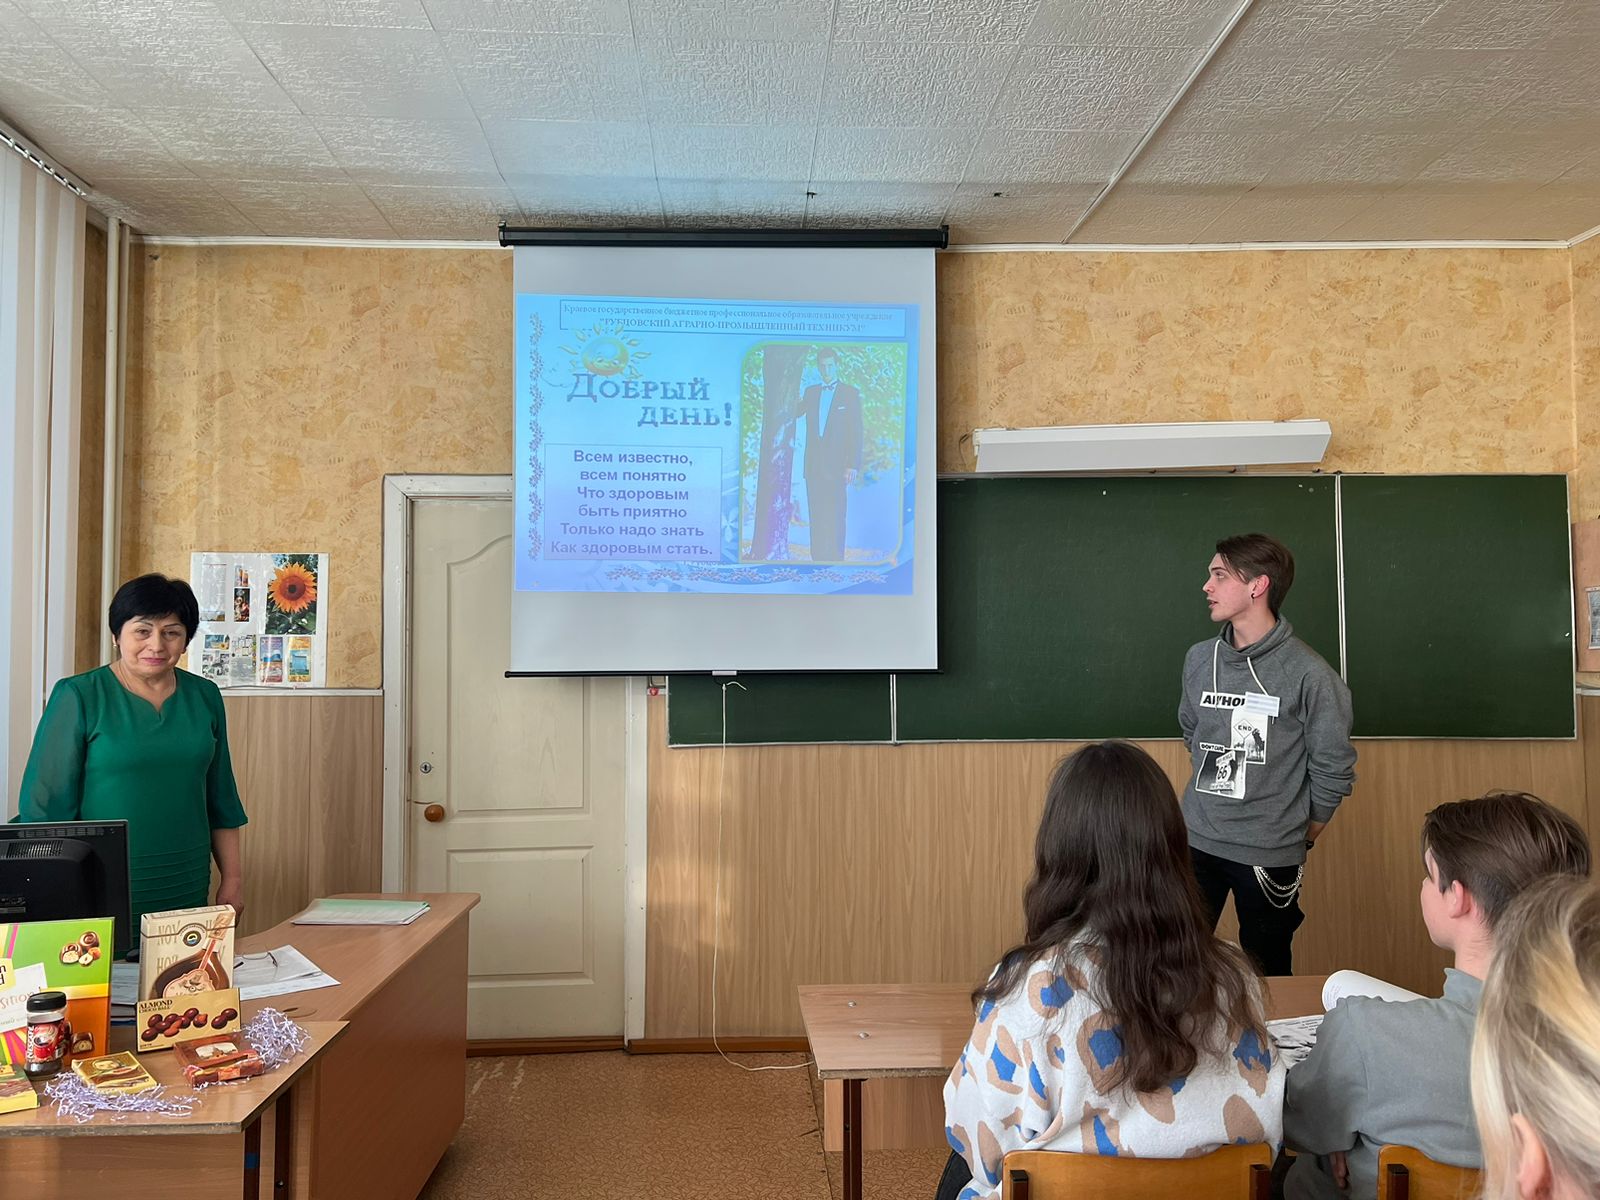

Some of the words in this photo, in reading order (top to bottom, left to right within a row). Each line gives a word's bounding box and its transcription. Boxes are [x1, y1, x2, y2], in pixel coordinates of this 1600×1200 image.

[564, 304, 597, 313] Краевое
[598, 306, 663, 316] государственное
[664, 307, 707, 316] бюджетное
[709, 308, 781, 319] профессиональное
[672, 319, 806, 331] АГРАРНО-ПРОМЫШЛЕННЫЙ
[574, 450, 613, 463] Всем
[618, 453, 693, 466] известно,
[580, 470, 618, 481] всем
[622, 471, 687, 482] понятно
[577, 486, 605, 499] Что
[609, 489, 689, 501] здоровым
[578, 504, 620, 517] быть
[623, 507, 688, 520] приятно
[560, 522, 615, 535] Только
[619, 525, 657, 537] надо
[661, 526, 705, 537] знать
[551, 541, 577, 553] Как
[581, 542, 662, 556] здоровым
[666, 544, 713, 555] стать.
[139, 999, 173, 1010] ALMOND
